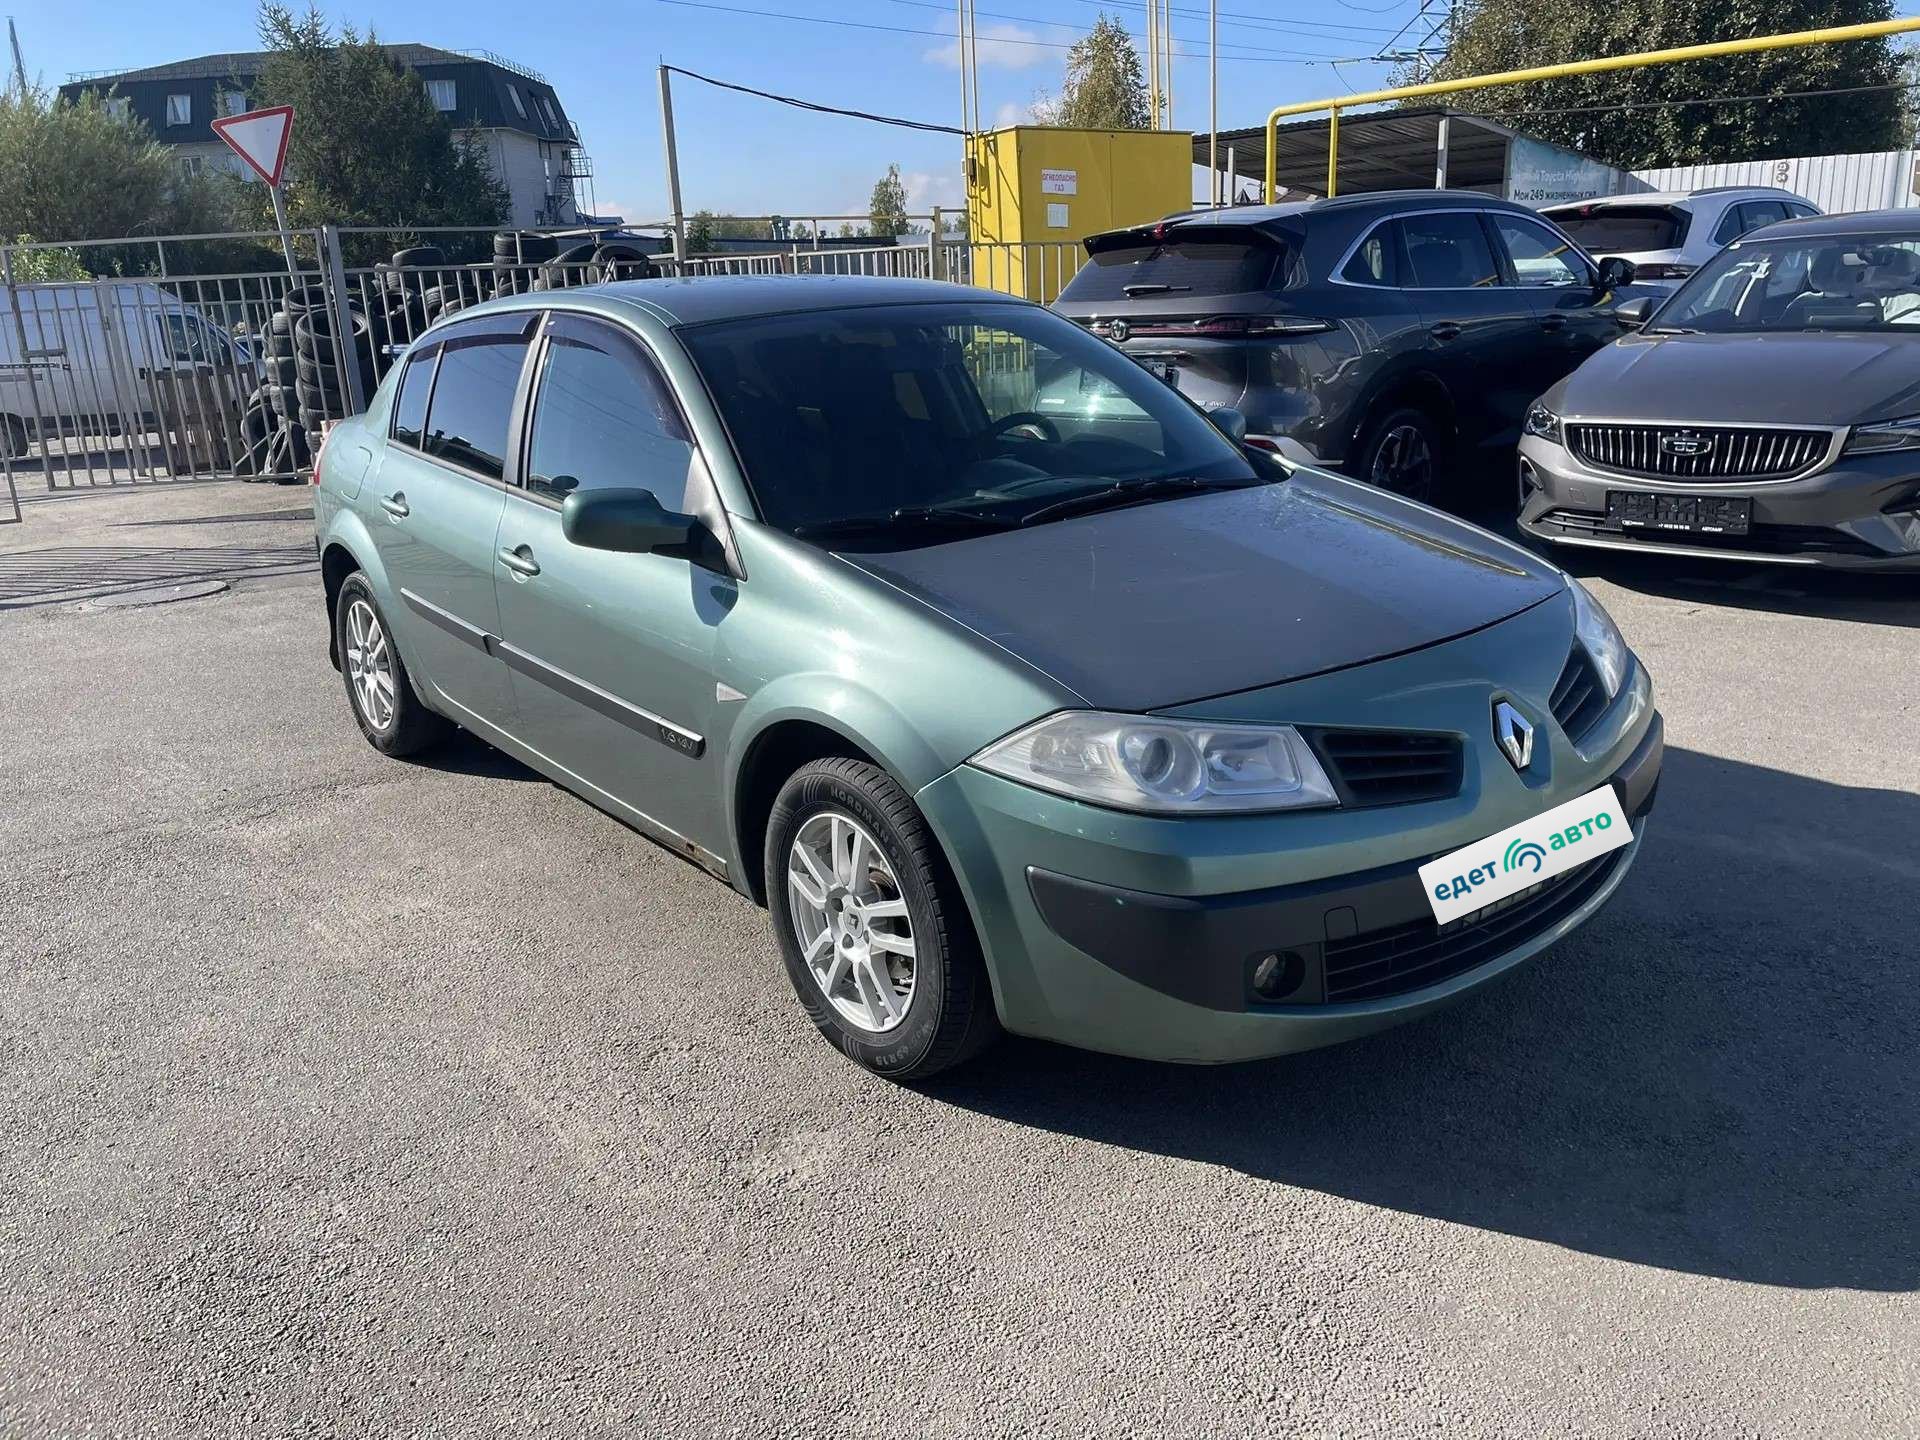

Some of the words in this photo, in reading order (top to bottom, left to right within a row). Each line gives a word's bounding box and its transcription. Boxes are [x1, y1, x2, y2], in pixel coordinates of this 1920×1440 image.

[1054, 184, 1064, 192] ГАЗ
[1513, 188, 1530, 200] Мои
[1530, 188, 1545, 201] 249
